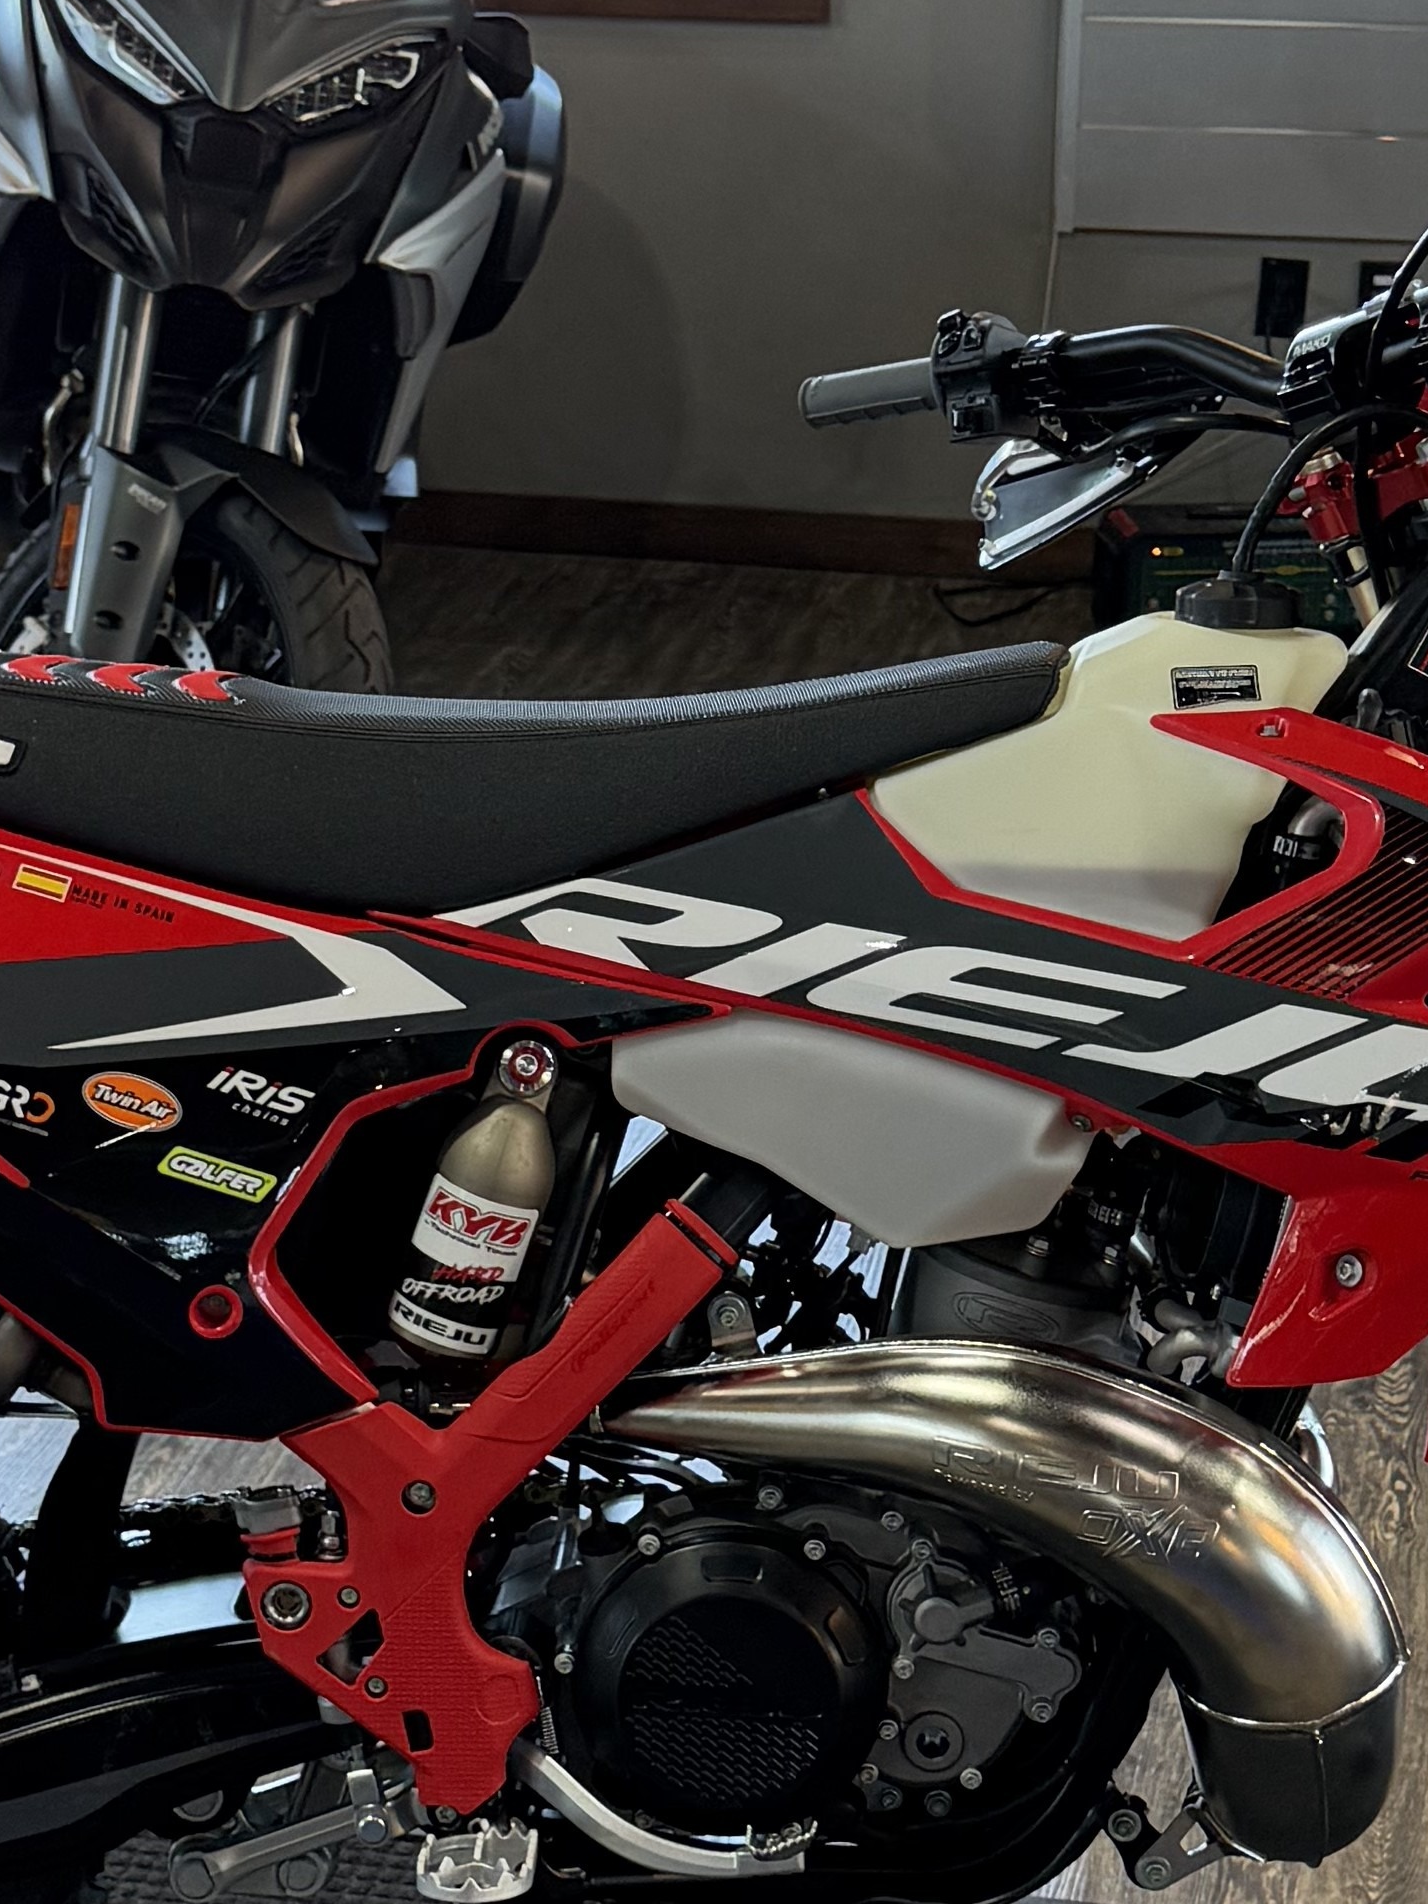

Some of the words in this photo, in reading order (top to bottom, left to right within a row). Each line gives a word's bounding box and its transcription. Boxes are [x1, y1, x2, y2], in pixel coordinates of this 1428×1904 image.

[73, 884, 108, 905] MADE
[113, 898, 129, 910] IN
[134, 902, 176, 924] SPAIN
[93, 1084, 142, 1112] Twin
[142, 1098, 179, 1121] Air
[231, 1101, 291, 1126] chains
[169, 1154, 265, 1195] GALFER
[425, 1186, 532, 1248] KYB
[401, 1277, 506, 1305] OFFROAD
[432, 1263, 505, 1284] HARD
[393, 1299, 487, 1346] RIEJU
